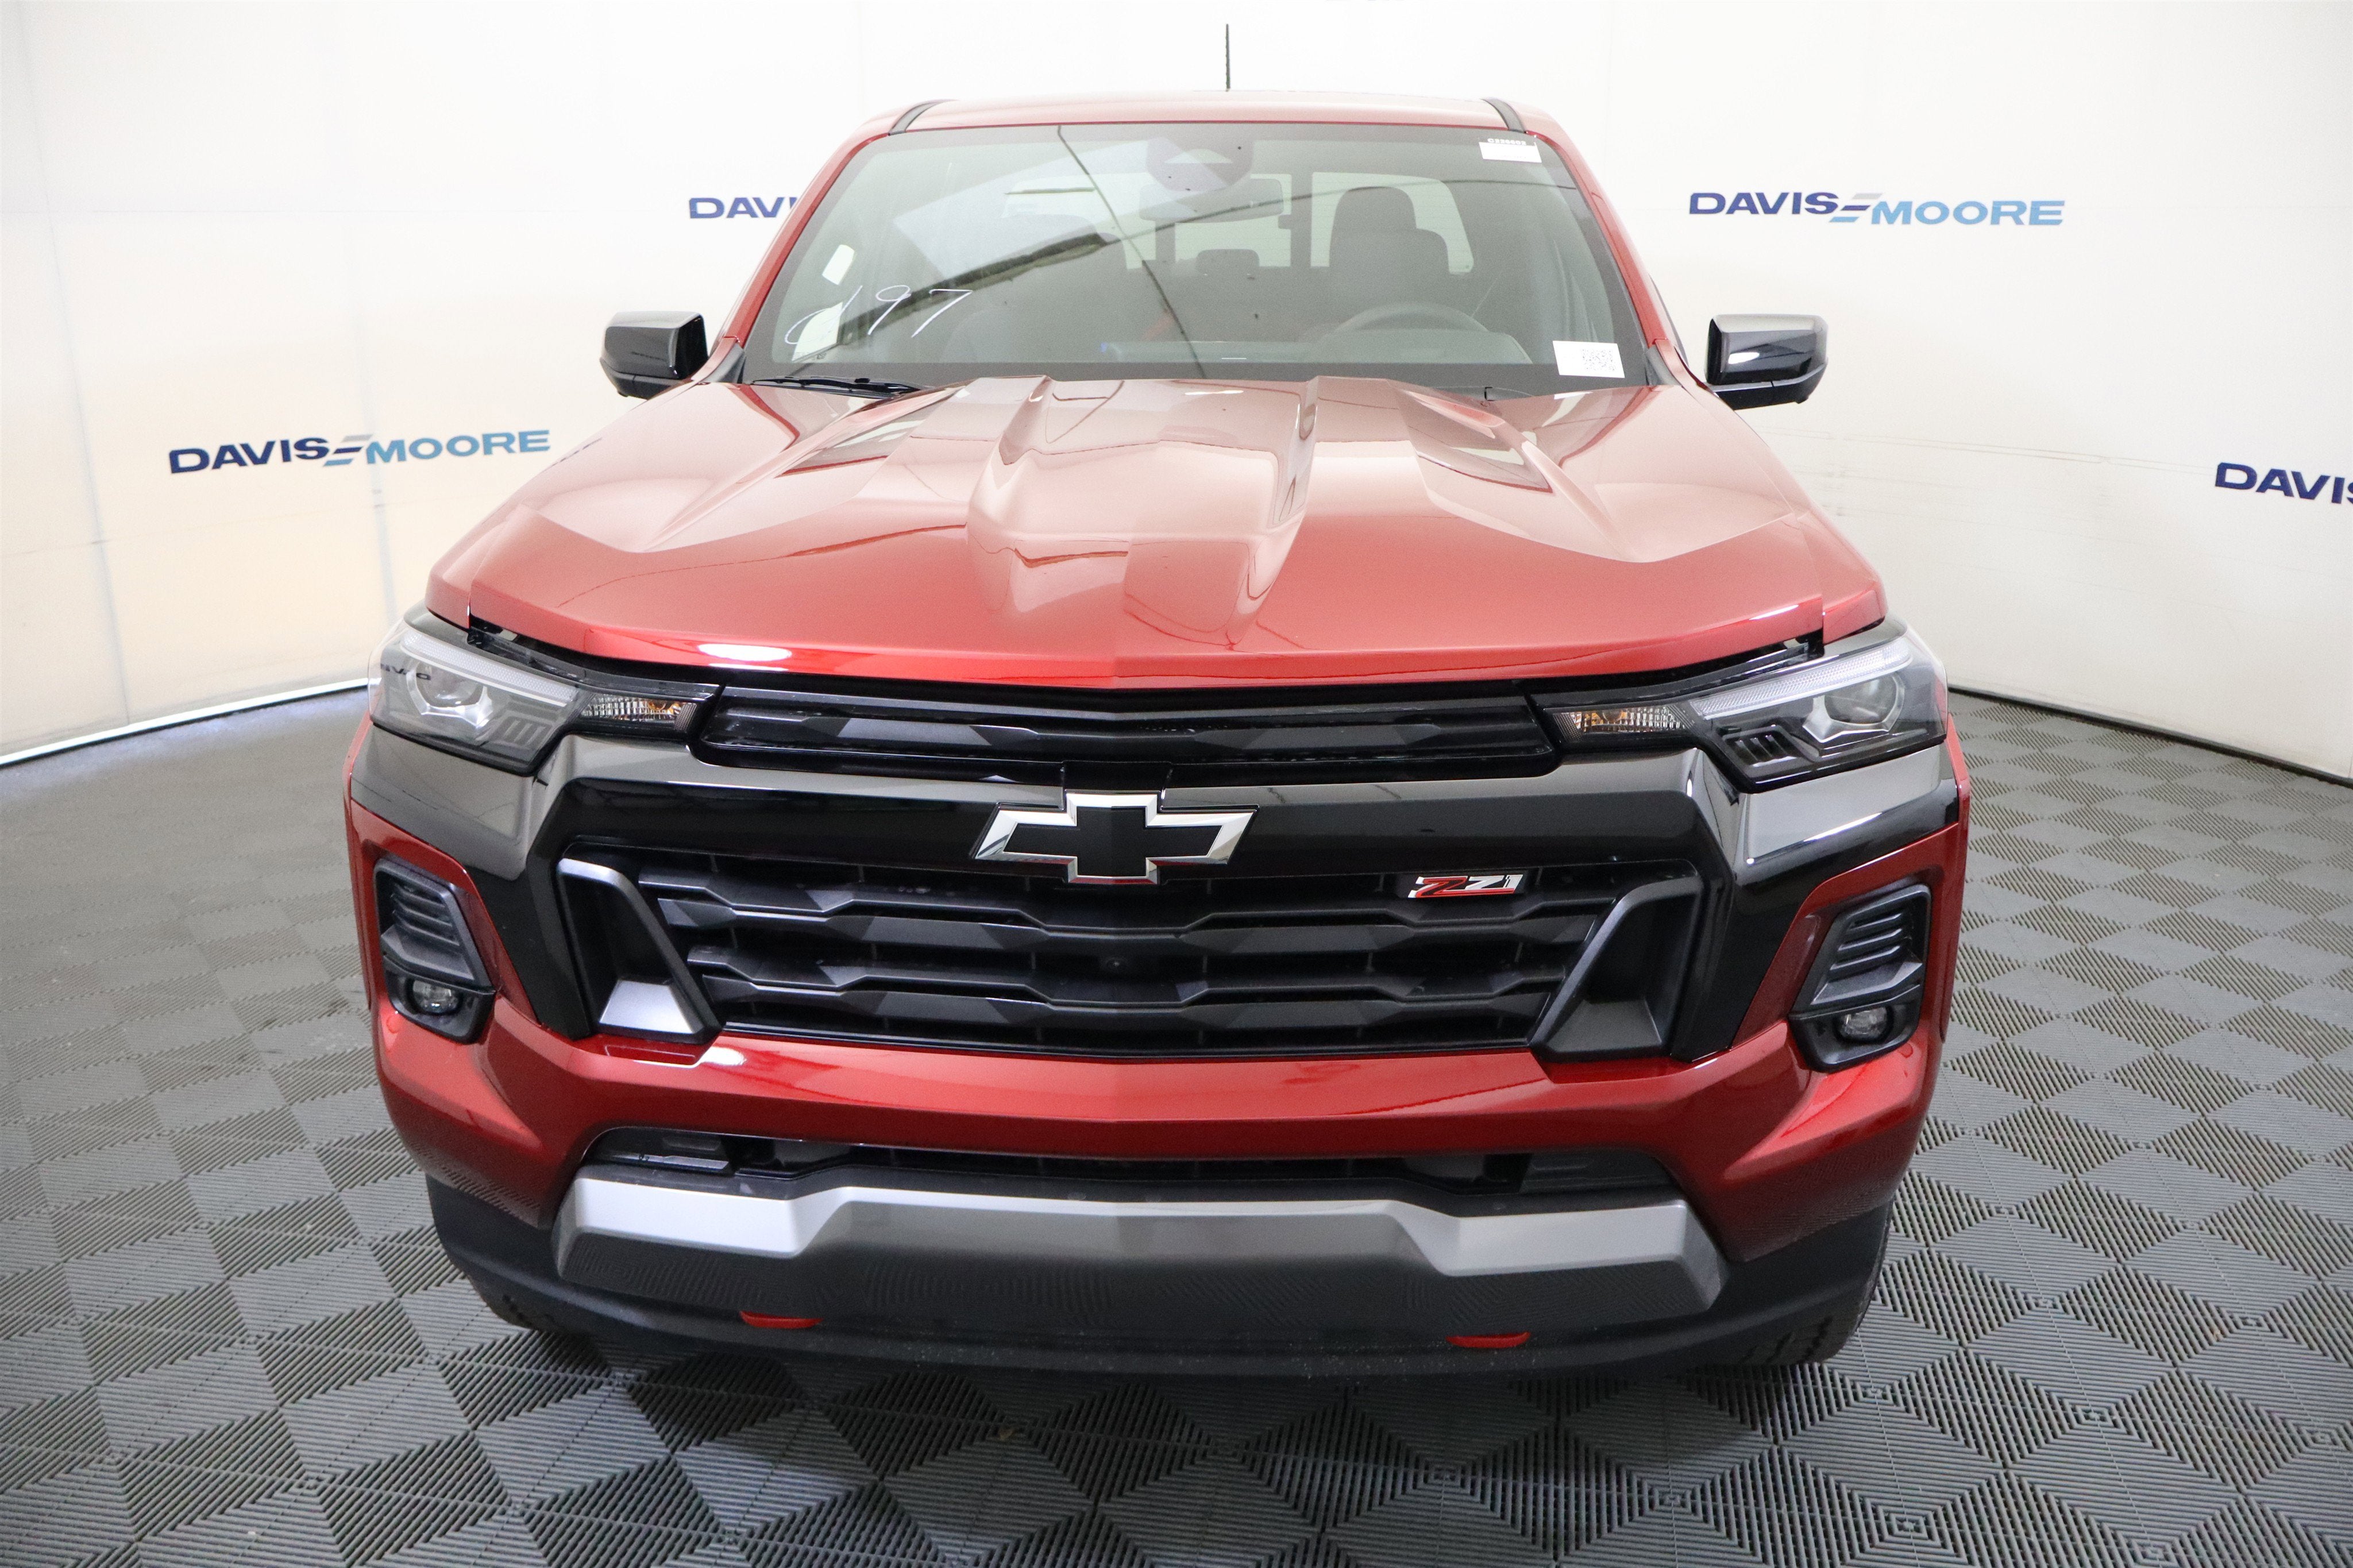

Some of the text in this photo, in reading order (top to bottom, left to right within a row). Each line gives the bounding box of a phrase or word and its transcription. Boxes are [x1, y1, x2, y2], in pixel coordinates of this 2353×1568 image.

[1689, 191, 2066, 226] DAVIS MOORE
[168, 429, 551, 474] DAVIS MOORE
[2215, 461, 2353, 505] DAVI
